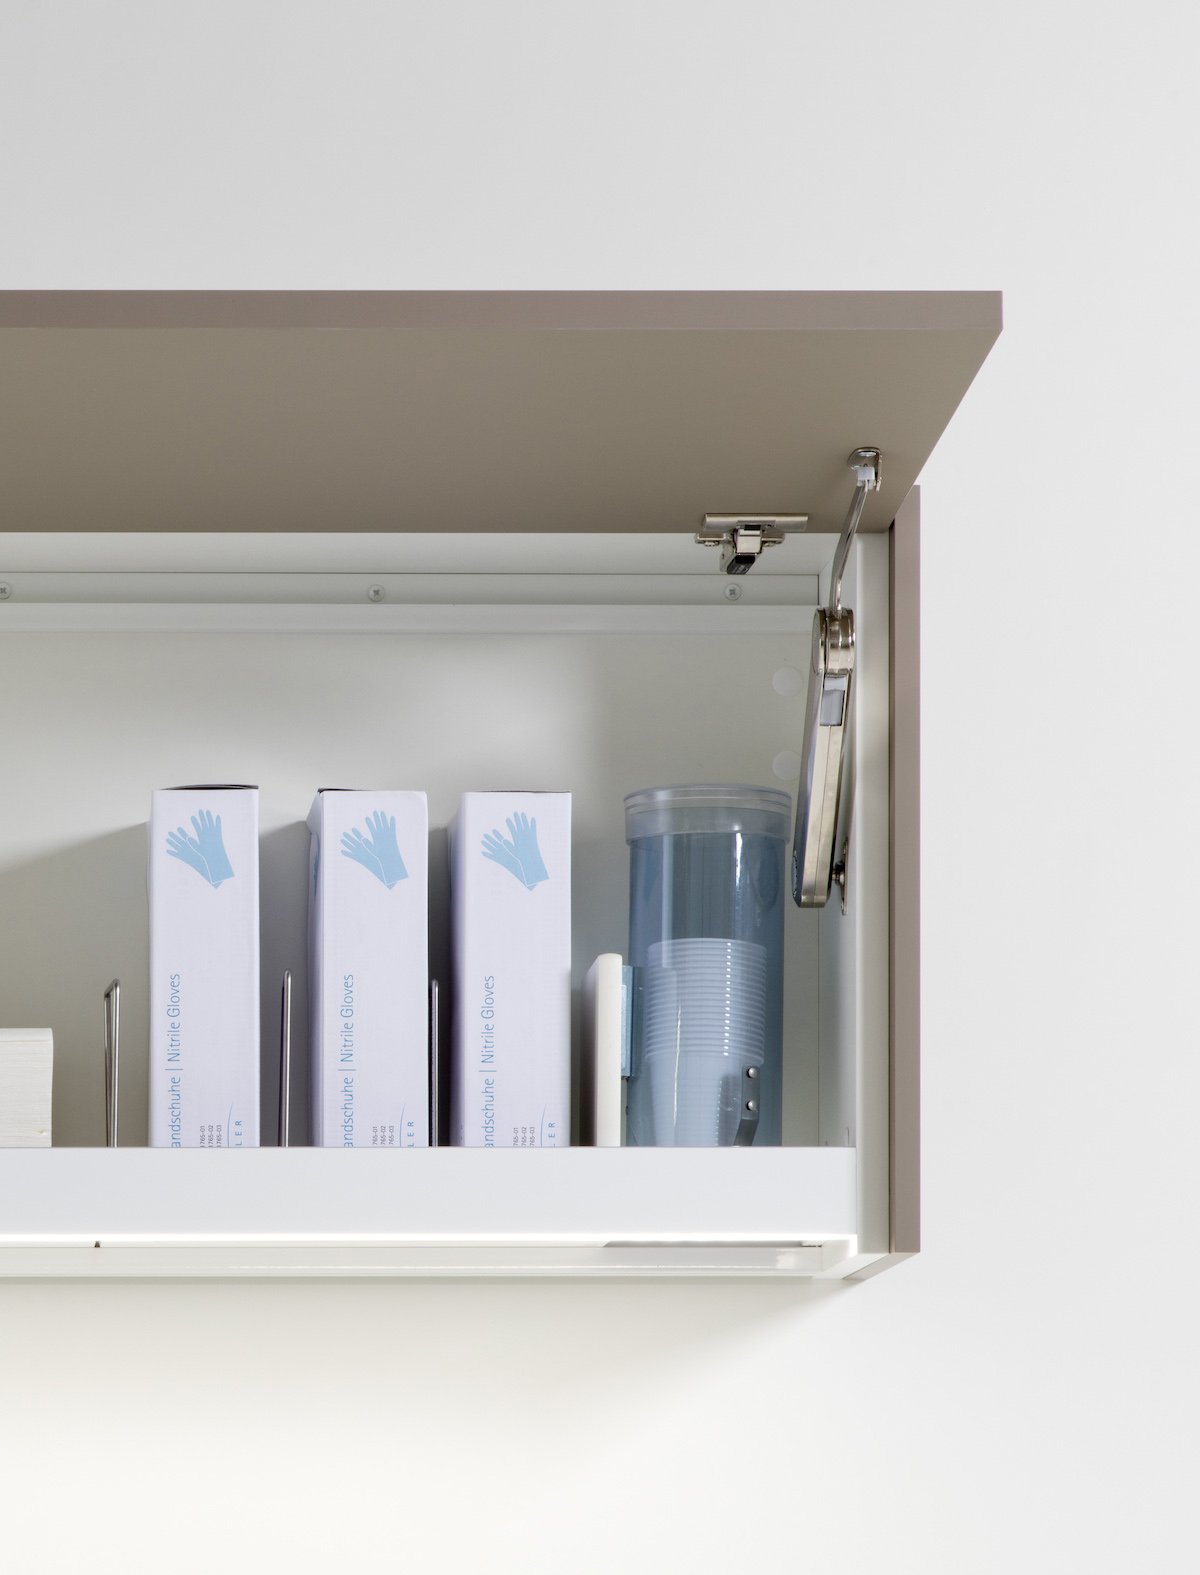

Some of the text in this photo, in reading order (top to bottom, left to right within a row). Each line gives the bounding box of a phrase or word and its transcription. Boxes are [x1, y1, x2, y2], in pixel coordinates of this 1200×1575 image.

[166, 973, 181, 1018] Gloves
[340, 974, 354, 1018] Gloves
[480, 975, 495, 1020] Gloves
[166, 1022, 181, 1062] Nitrile
[340, 1022, 354, 1062] Nitrile
[480, 1023, 495, 1064] Nitrile
